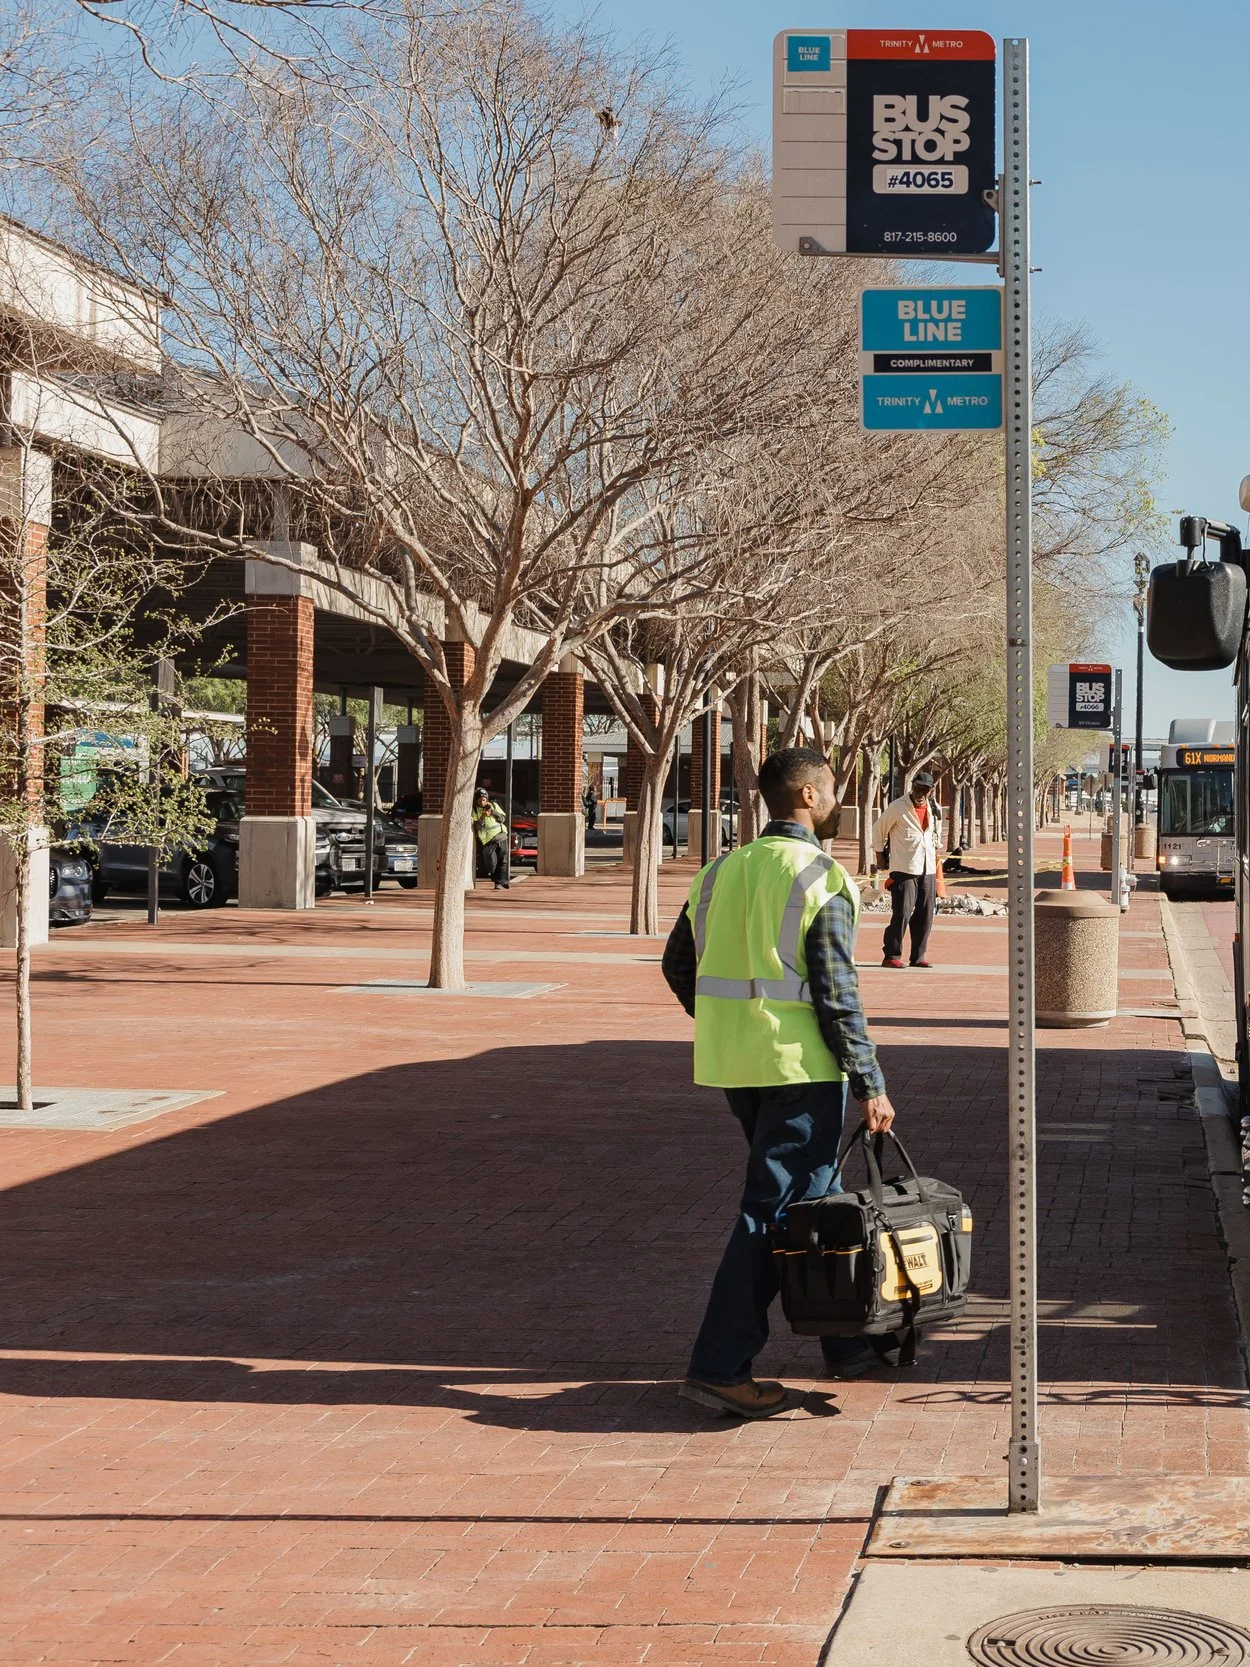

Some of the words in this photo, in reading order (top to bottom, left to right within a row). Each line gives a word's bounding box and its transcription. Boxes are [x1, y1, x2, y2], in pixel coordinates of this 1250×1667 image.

[880, 40, 913, 48] TRINITY
[932, 40, 963, 48] METRO
[873, 94, 971, 132] BUS
[872, 131, 970, 161] STOP
[887, 171, 954, 189] #4065
[883, 231, 957, 242] 817-215-8600
[897, 300, 966, 320] BLUE
[904, 322, 962, 342] LINE
[890, 359, 975, 368] COMPLIMENTARY
[877, 397, 921, 406] TRINITY
[947, 396, 988, 406] METRO
[1076, 682, 1105, 694] BUS
[1075, 693, 1105, 702] STOP
[1185, 751, 1202, 765] 61X
[896, 1255, 927, 1269] WALT
